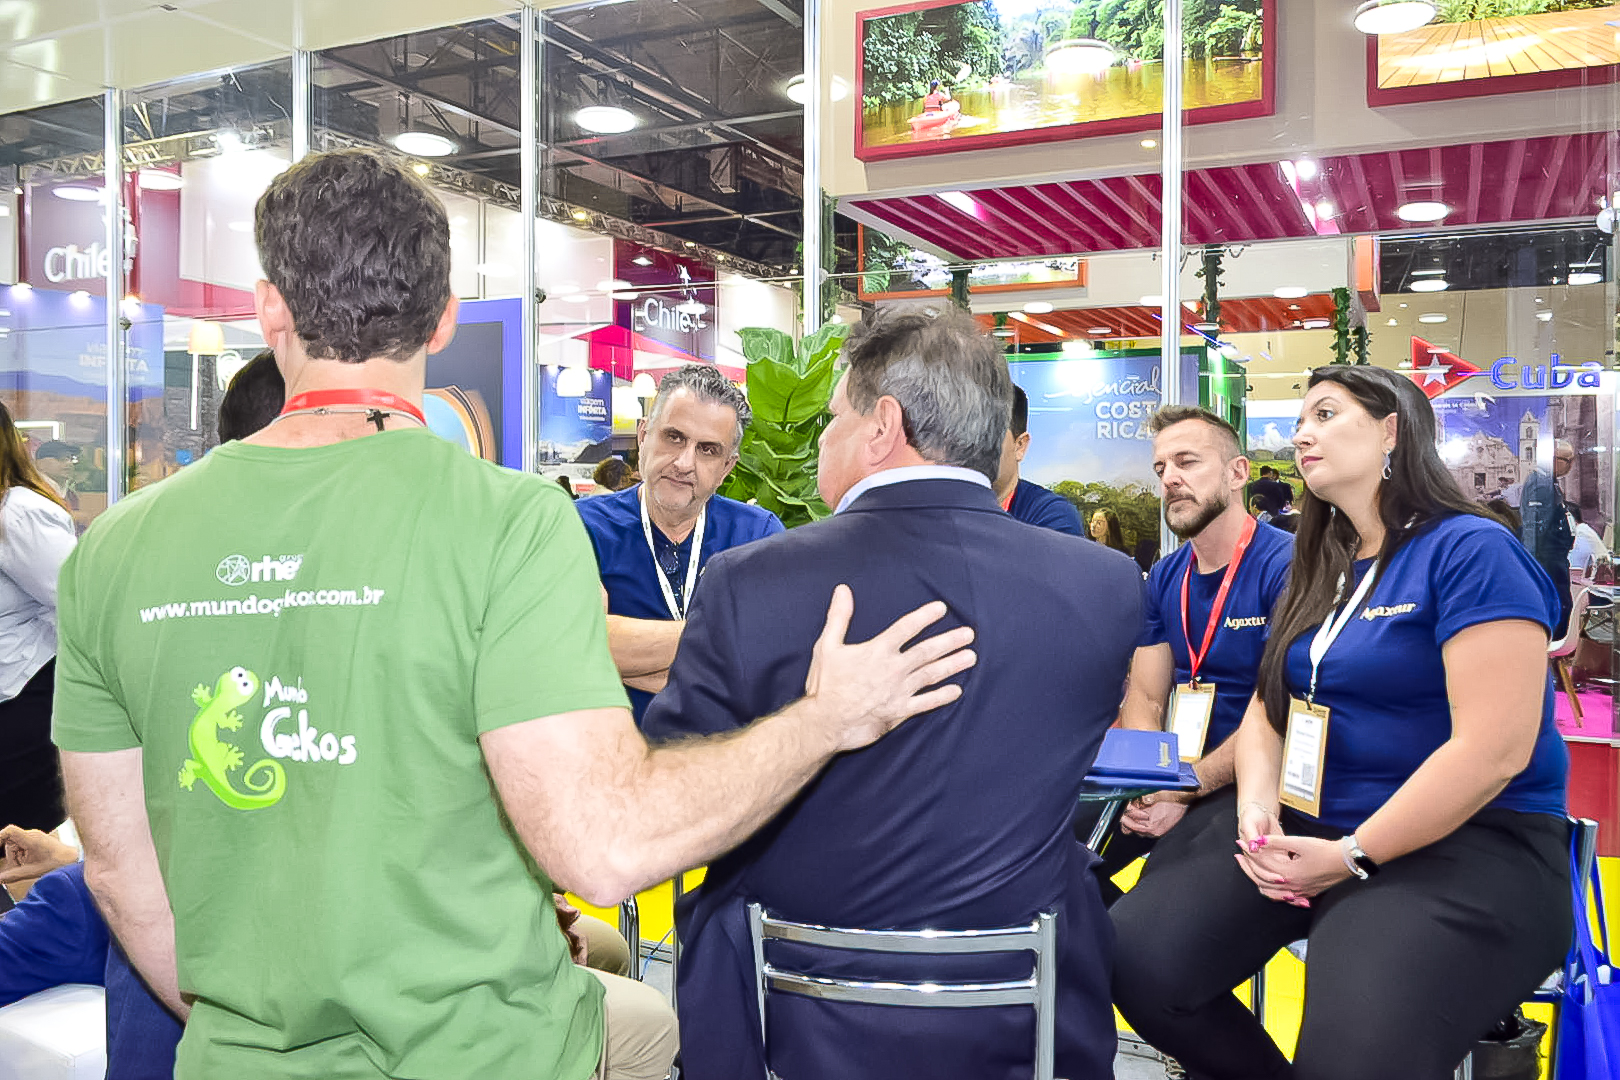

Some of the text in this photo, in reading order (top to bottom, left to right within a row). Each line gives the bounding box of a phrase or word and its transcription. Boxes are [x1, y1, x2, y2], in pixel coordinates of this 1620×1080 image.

[44, 242, 108, 283] Chile
[643, 297, 692, 333] Chile
[1490, 353, 1601, 390] Cuba
[1095, 400, 1157, 420] COST
[139, 585, 385, 623] www.mundogko.com.br
